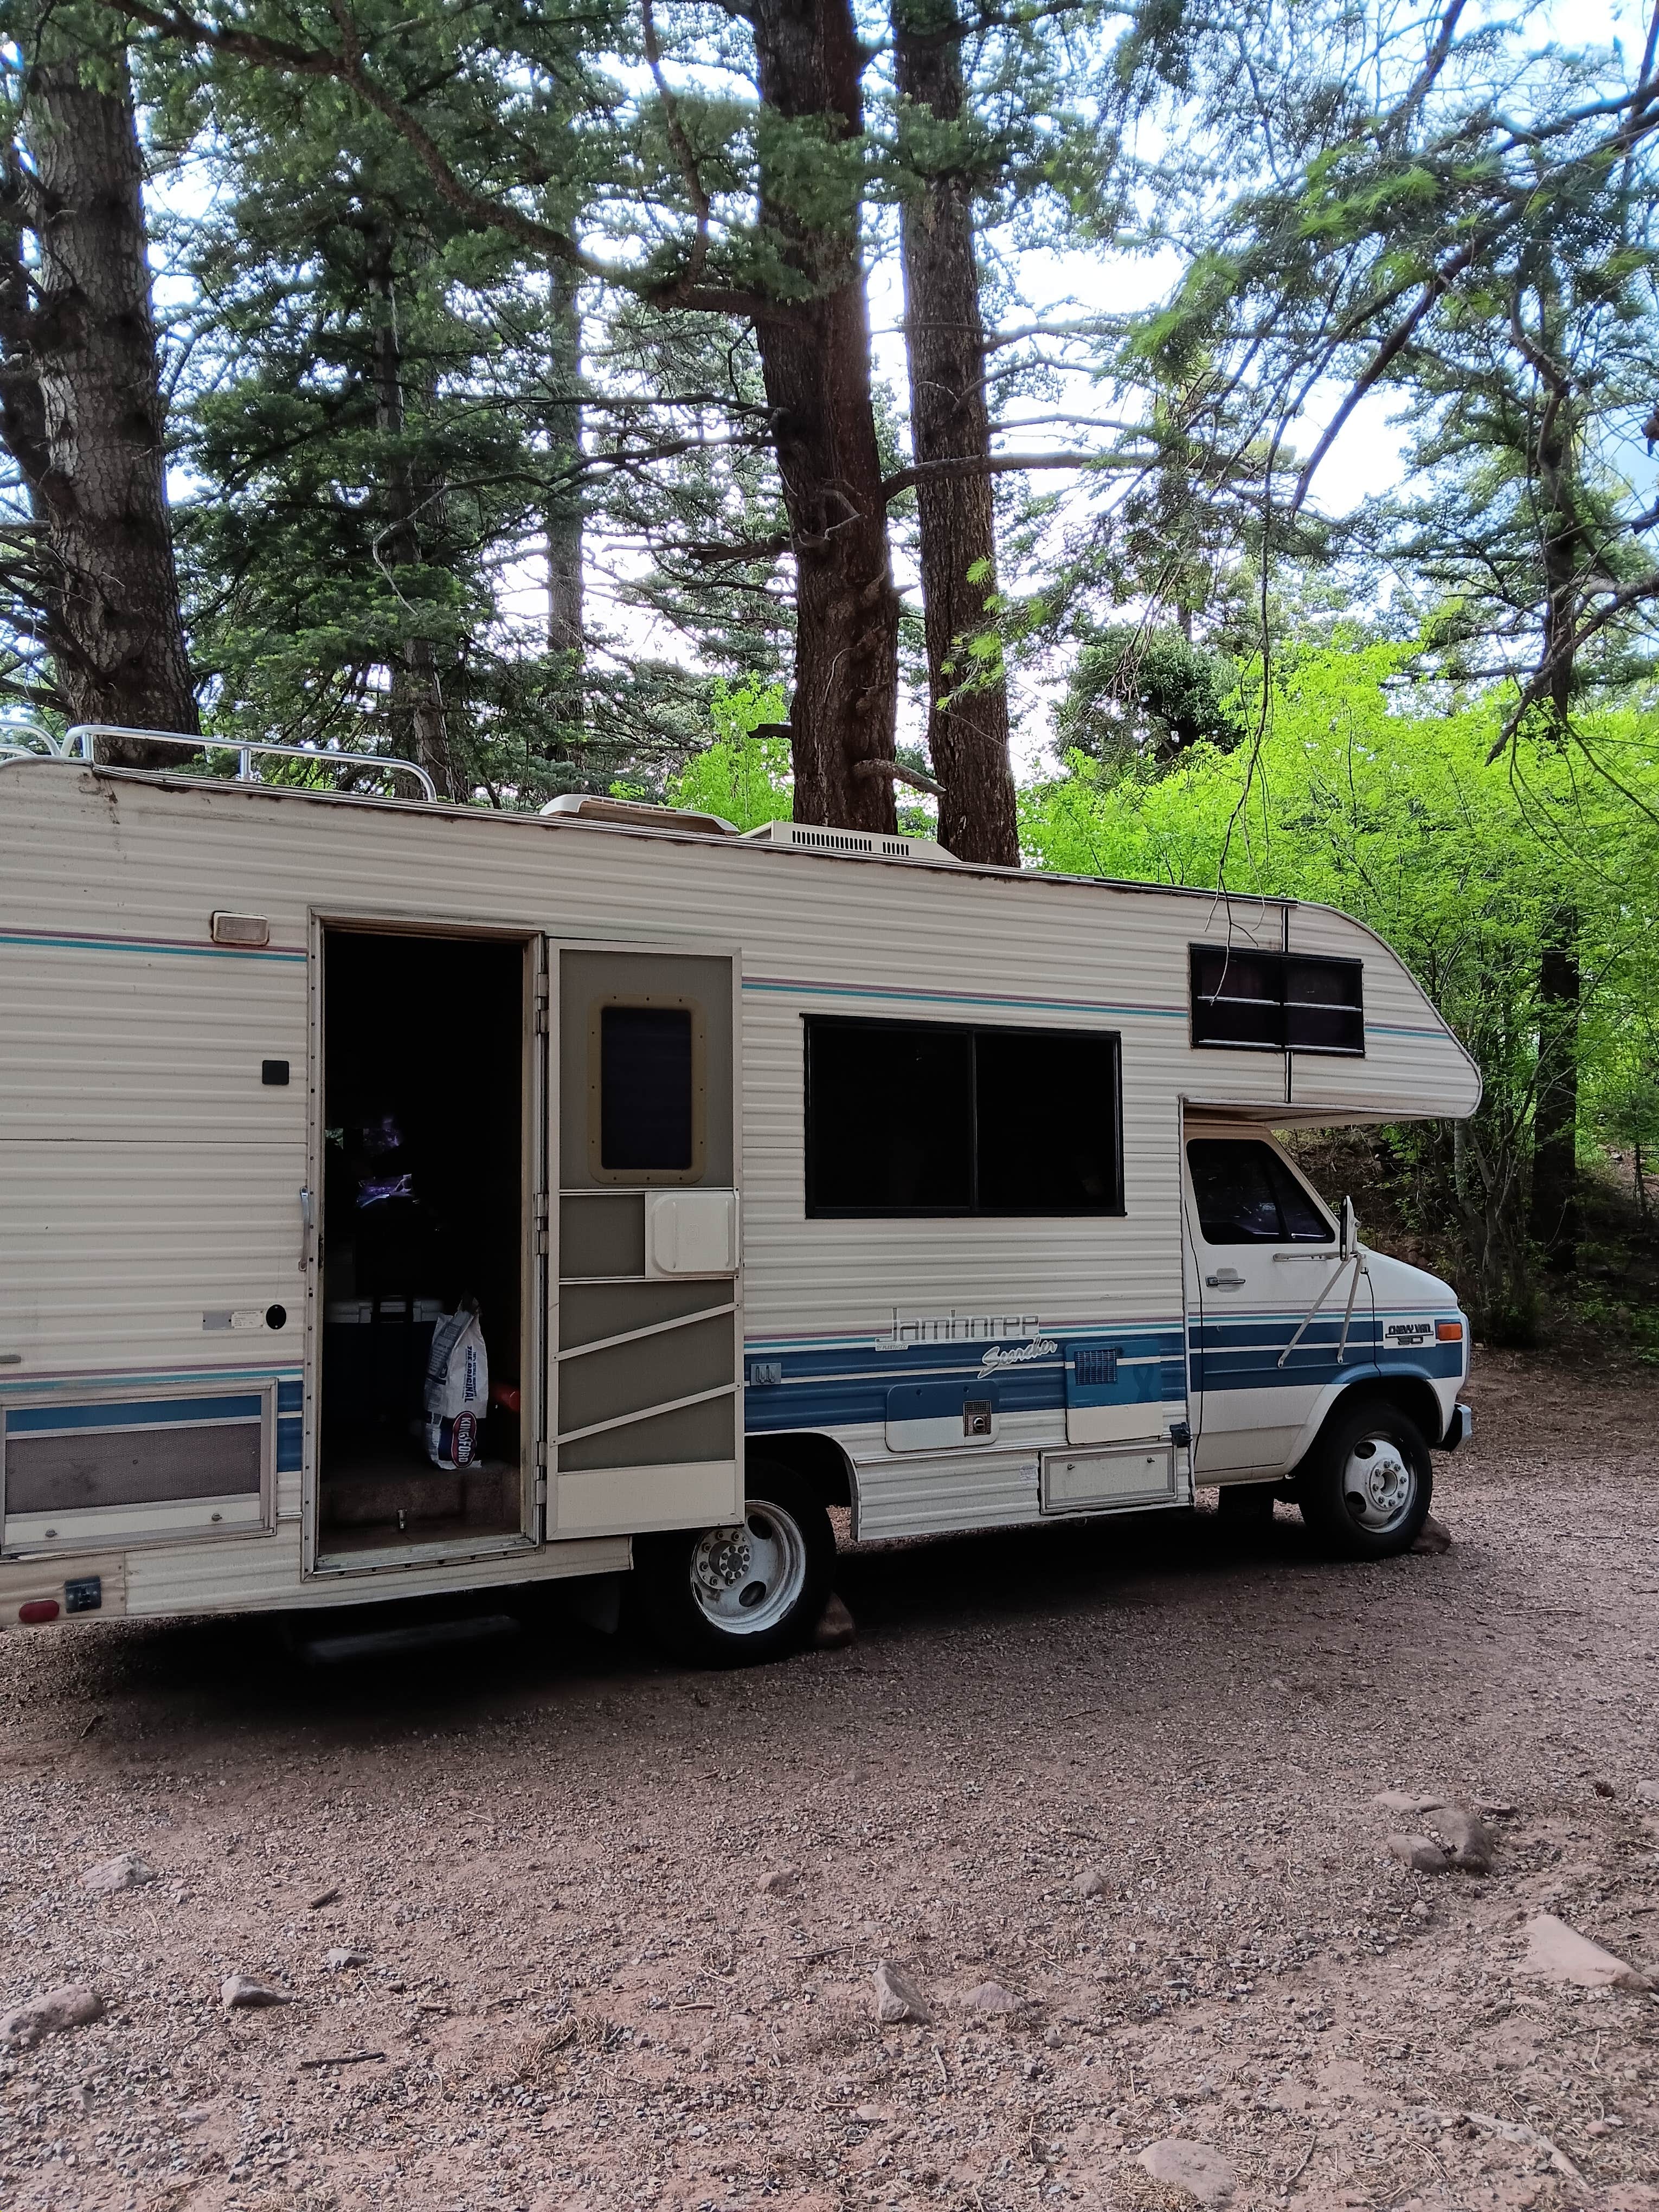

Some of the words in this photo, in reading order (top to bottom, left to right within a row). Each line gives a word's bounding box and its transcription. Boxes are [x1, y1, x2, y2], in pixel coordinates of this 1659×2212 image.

[876, 1307, 1039, 1342] Jamboree
[1388, 1325, 1414, 1334] CHEVY
[1414, 1323, 1431, 1333] VAN
[1398, 1336, 1423, 1345] 30
[977, 1337, 1058, 1379] Searcher
[465, 1363, 473, 1403] ORIGINAL
[458, 1417, 473, 1463] KINGSFORD
